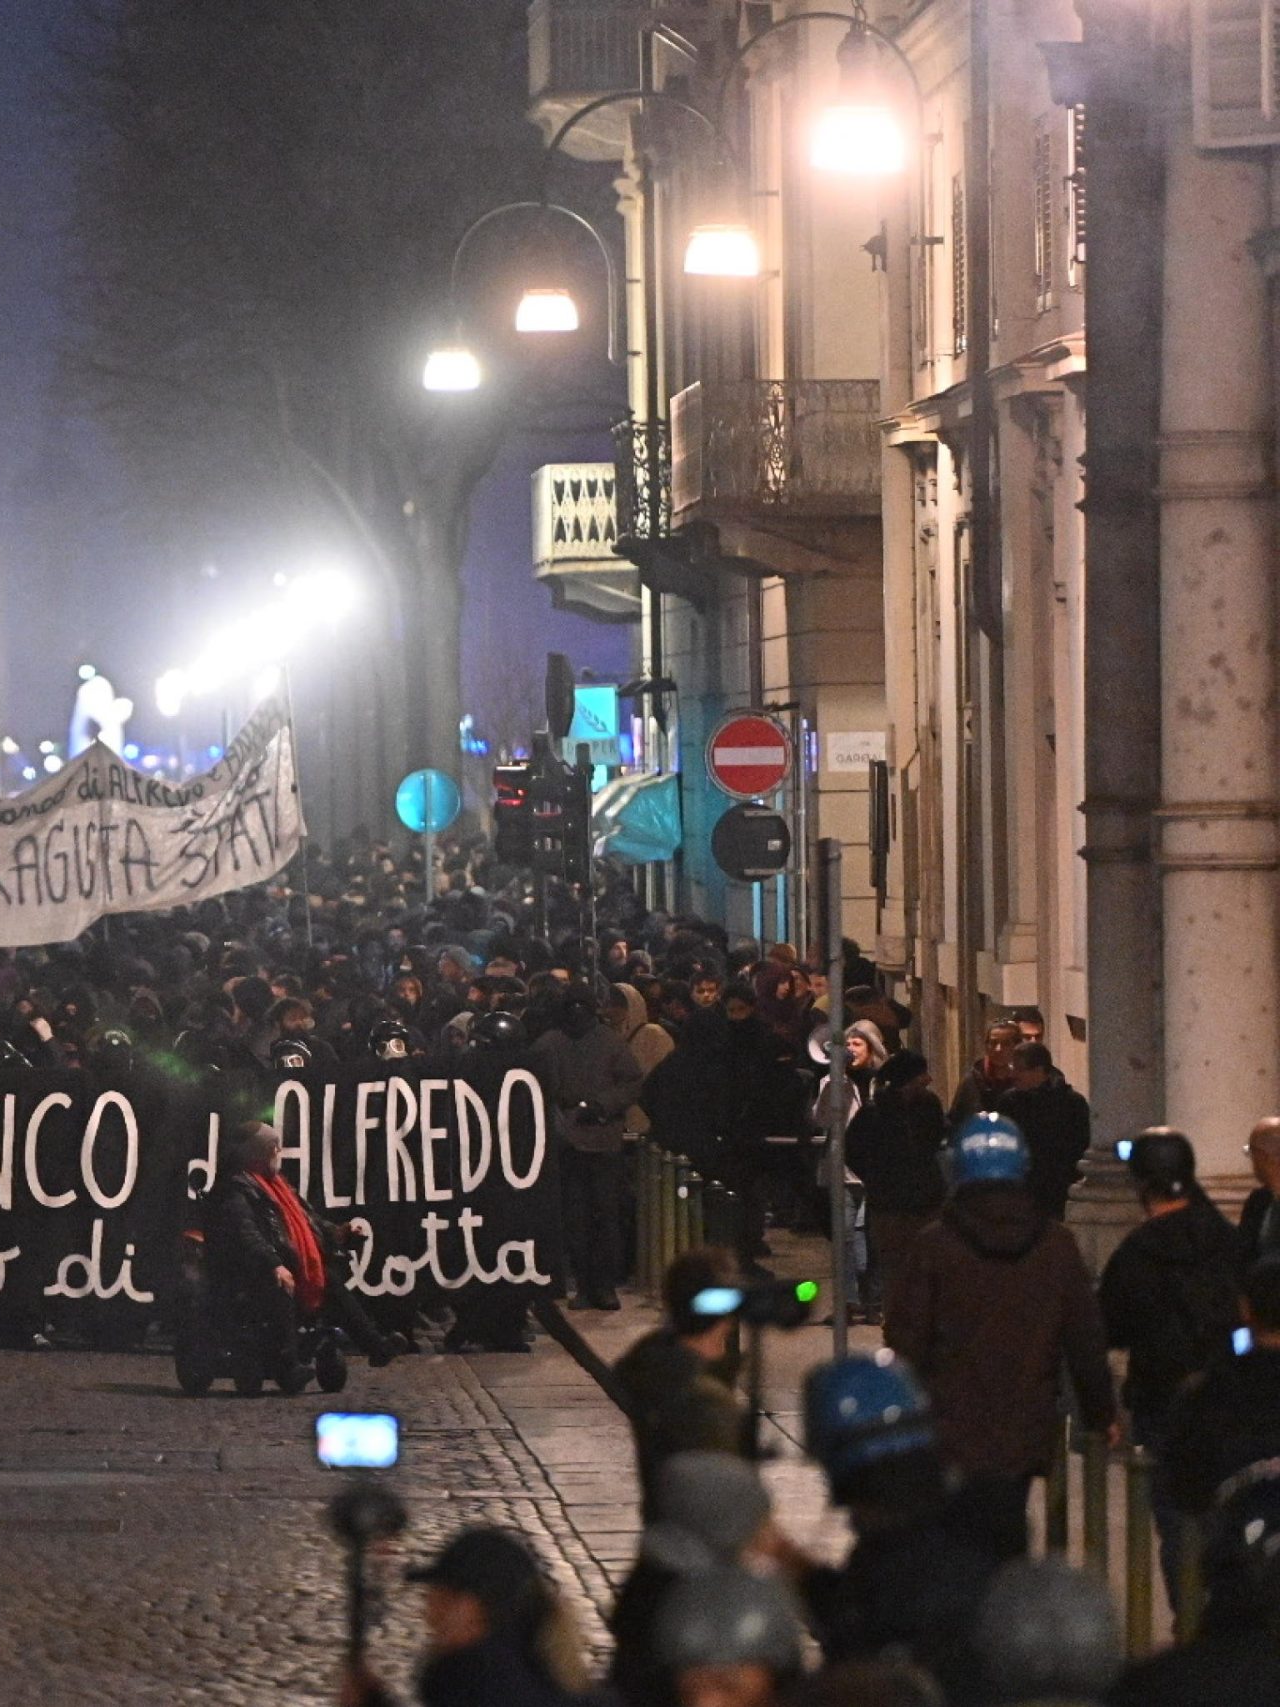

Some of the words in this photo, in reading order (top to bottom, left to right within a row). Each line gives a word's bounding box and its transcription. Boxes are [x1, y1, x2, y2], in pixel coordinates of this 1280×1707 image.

[77, 760, 106, 800] di
[187, 1111, 219, 1199] d
[272, 1068, 546, 1208] ALFREDO
[43, 1218, 154, 1302] di
[344, 1207, 551, 1298] lotta
